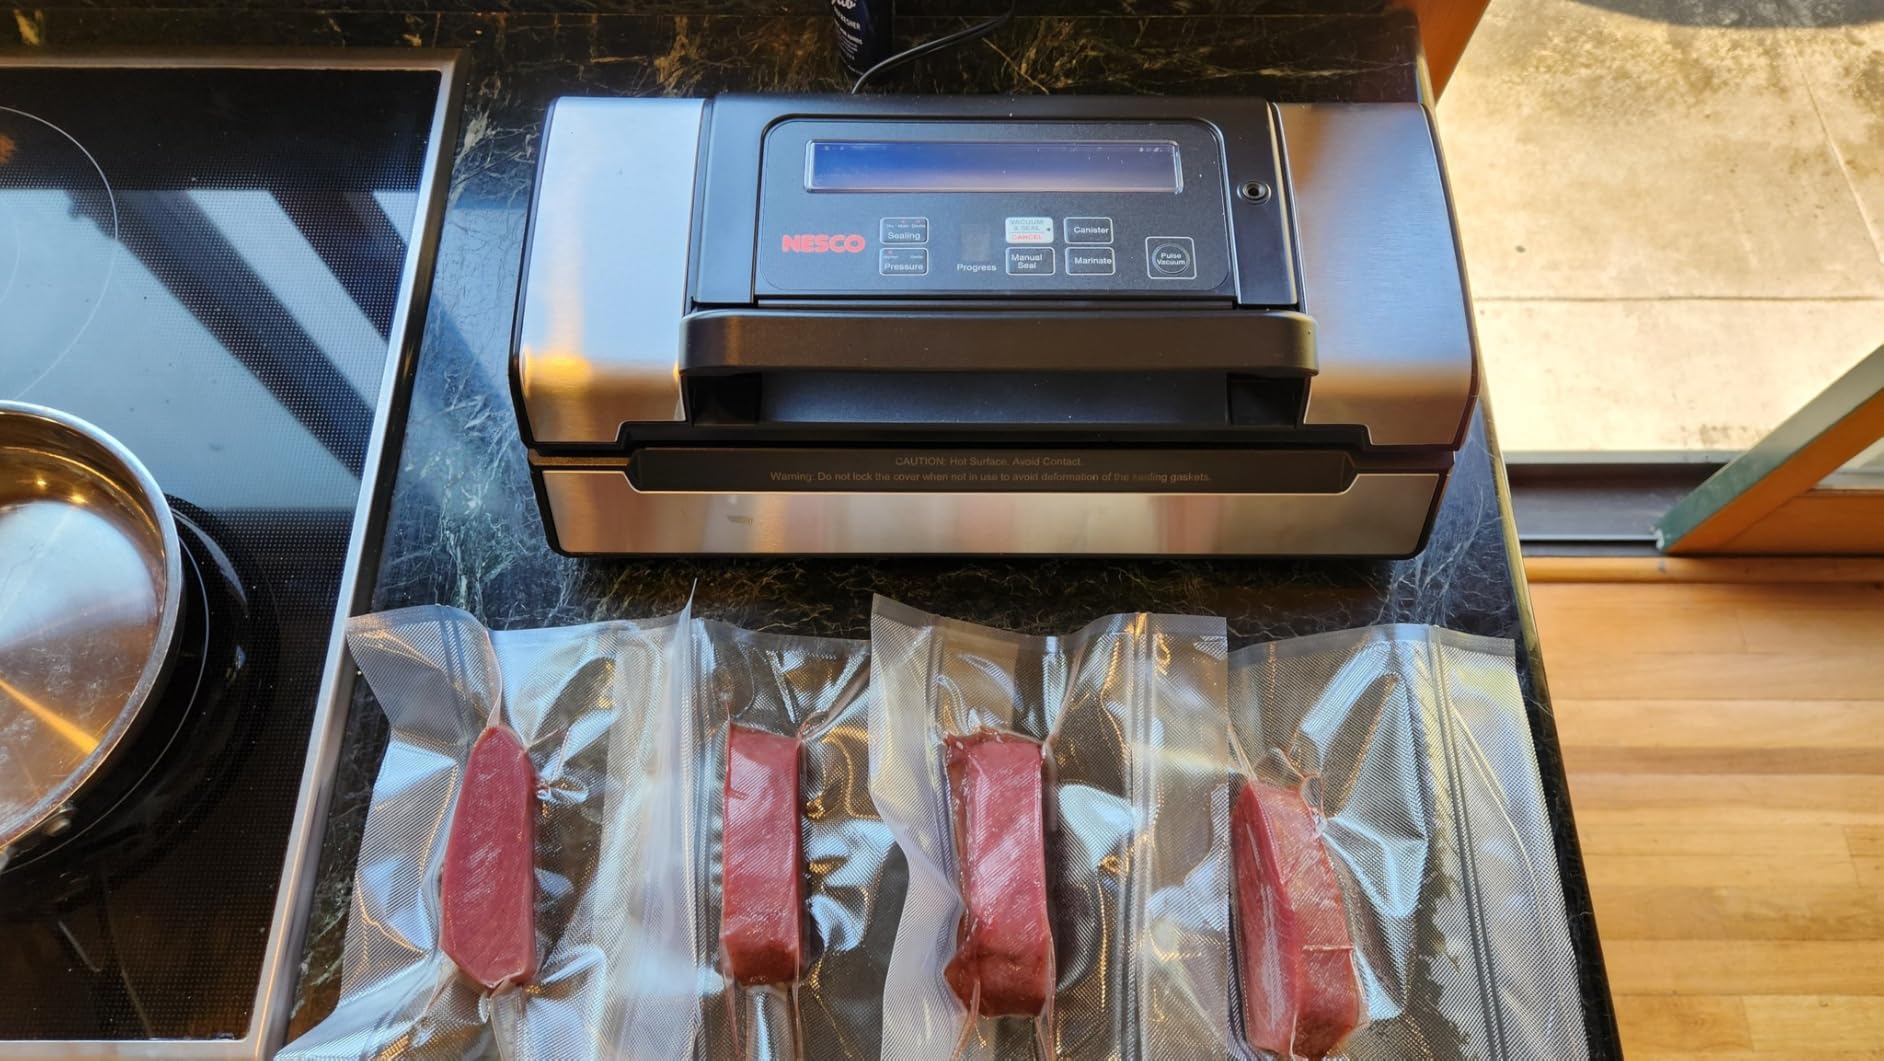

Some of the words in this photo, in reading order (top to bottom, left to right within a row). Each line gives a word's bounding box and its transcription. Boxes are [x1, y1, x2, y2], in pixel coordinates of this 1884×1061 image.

[1073, 226, 1110, 235] Canister
[887, 231, 921, 241] Sealing
[1011, 233, 1043, 241] CANCEL
[781, 234, 866, 253] NESCO
[1011, 253, 1043, 262] Manual
[1074, 256, 1113, 265] Marinate
[884, 262, 924, 271] Pressure
[956, 263, 998, 273] Progress
[1018, 261, 1037, 269] Seal
[895, 456, 946, 466] CAUTION:
[950, 456, 967, 466] Hot
[970, 456, 1009, 466] Surface.
[1012, 456, 1040, 466] Avoid
[770, 471, 815, 483] Warning:
[817, 471, 833, 481] Do
[835, 471, 850, 481] not
[852, 471, 873, 481] lock
[875, 471, 890, 481] the
[893, 472, 920, 481] cover
[922, 471, 948, 481] when
[951, 471, 967, 481] not
[969, 471, 978, 481] in
[980, 472, 998, 481] use
[1000, 471, 1010, 481] to
[1013, 471, 1039, 481] avoid
[1041, 471, 1099, 481] deformation
[1101, 471, 1112, 481] of
[1113, 471, 1129, 481] the
